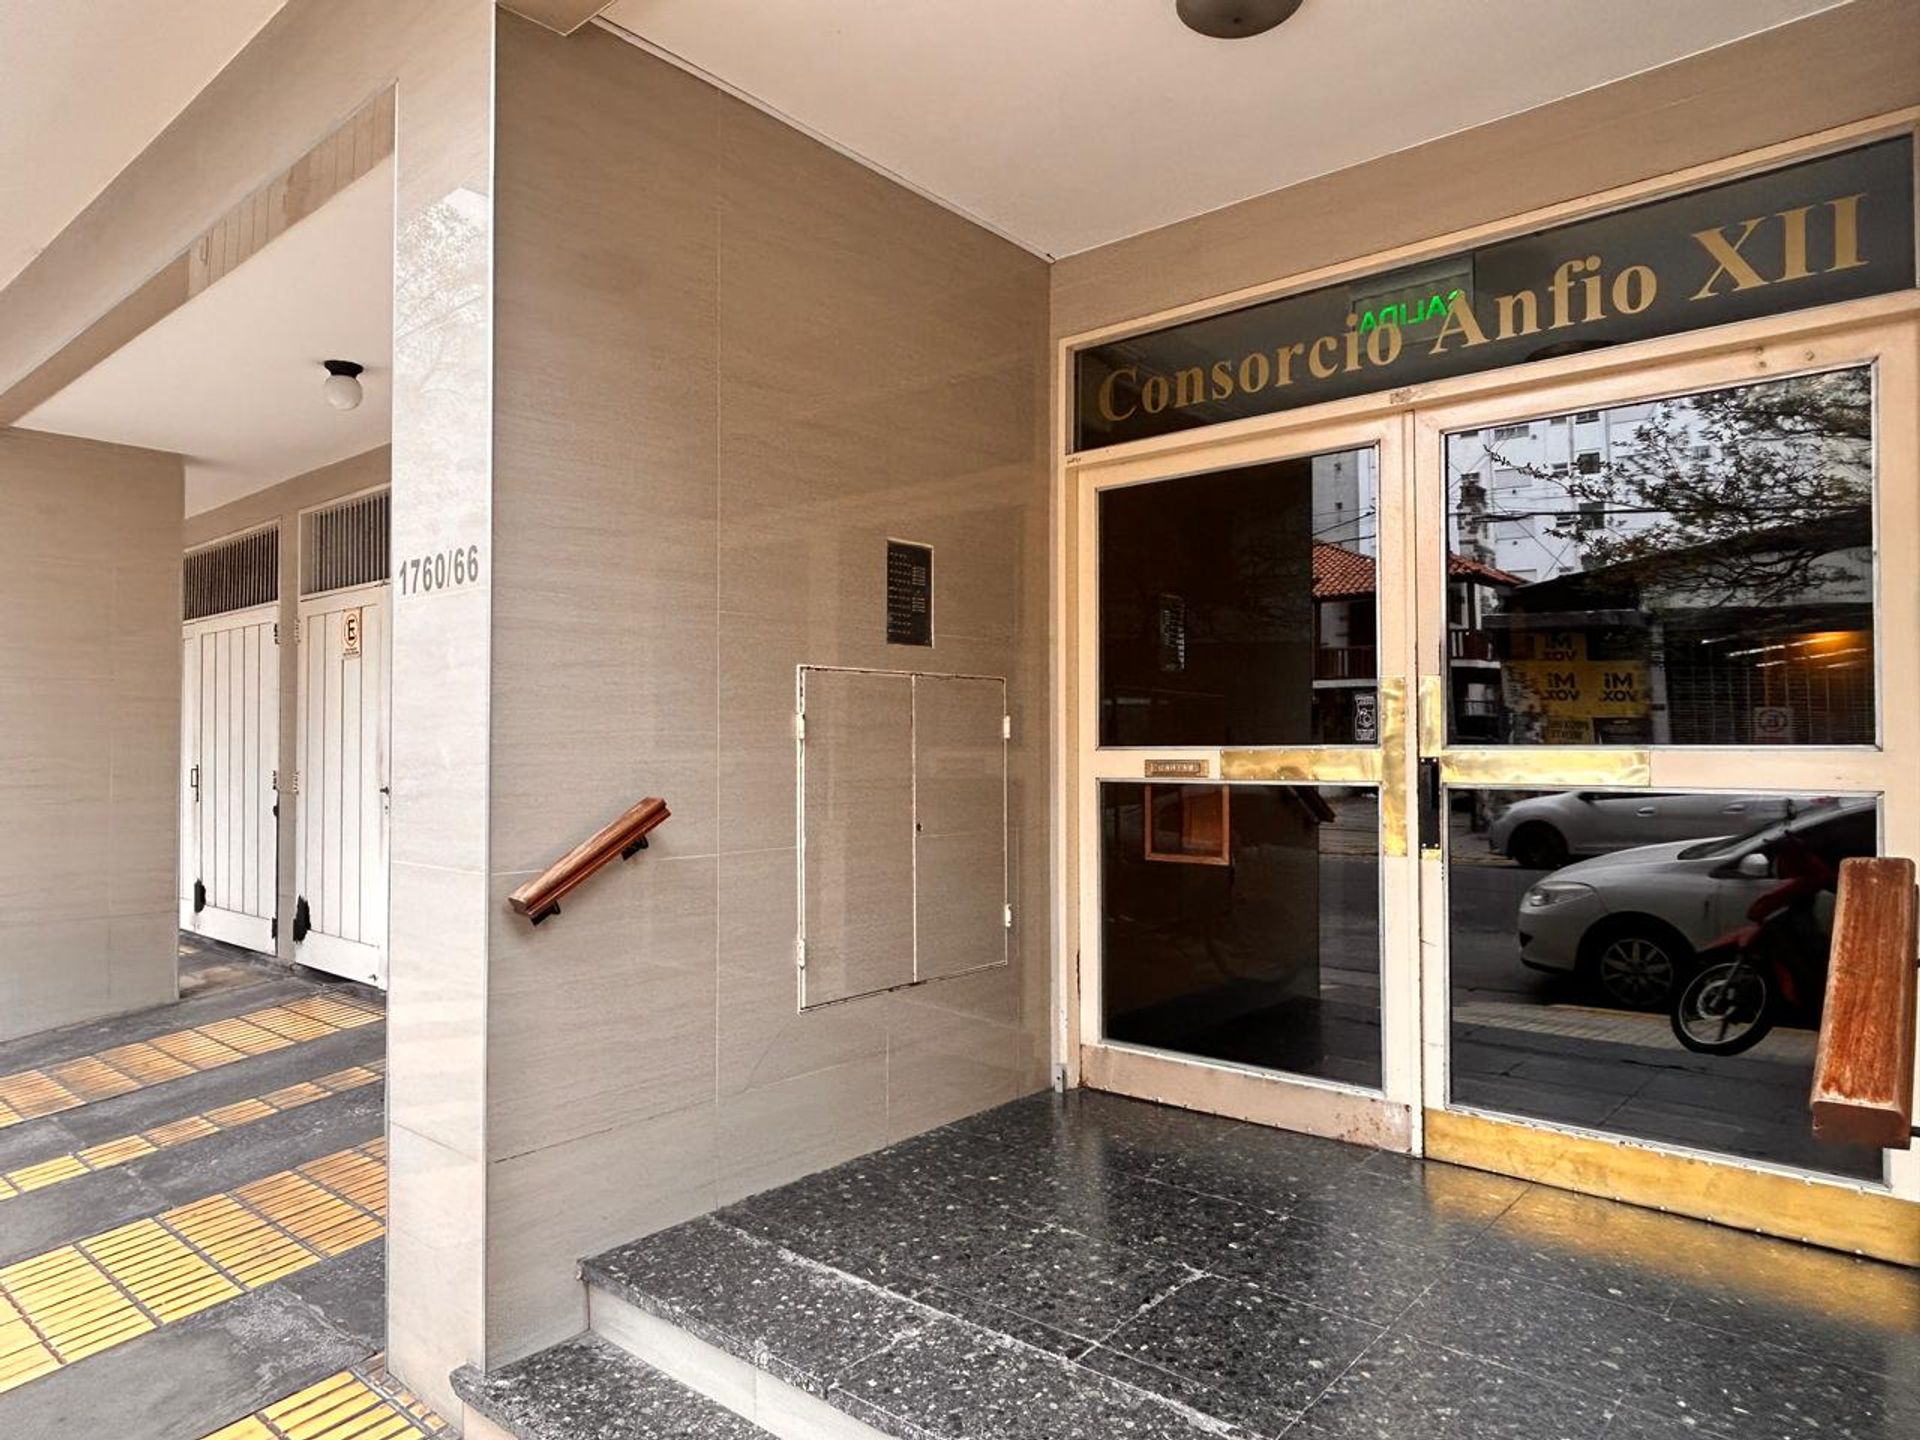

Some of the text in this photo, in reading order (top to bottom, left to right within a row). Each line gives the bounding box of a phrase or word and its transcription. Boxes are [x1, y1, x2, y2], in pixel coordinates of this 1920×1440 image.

[1100, 193, 1869, 421] Consorcio Anfio XII
[399, 544, 479, 596] 1760/66
[347, 619, 355, 641] E
